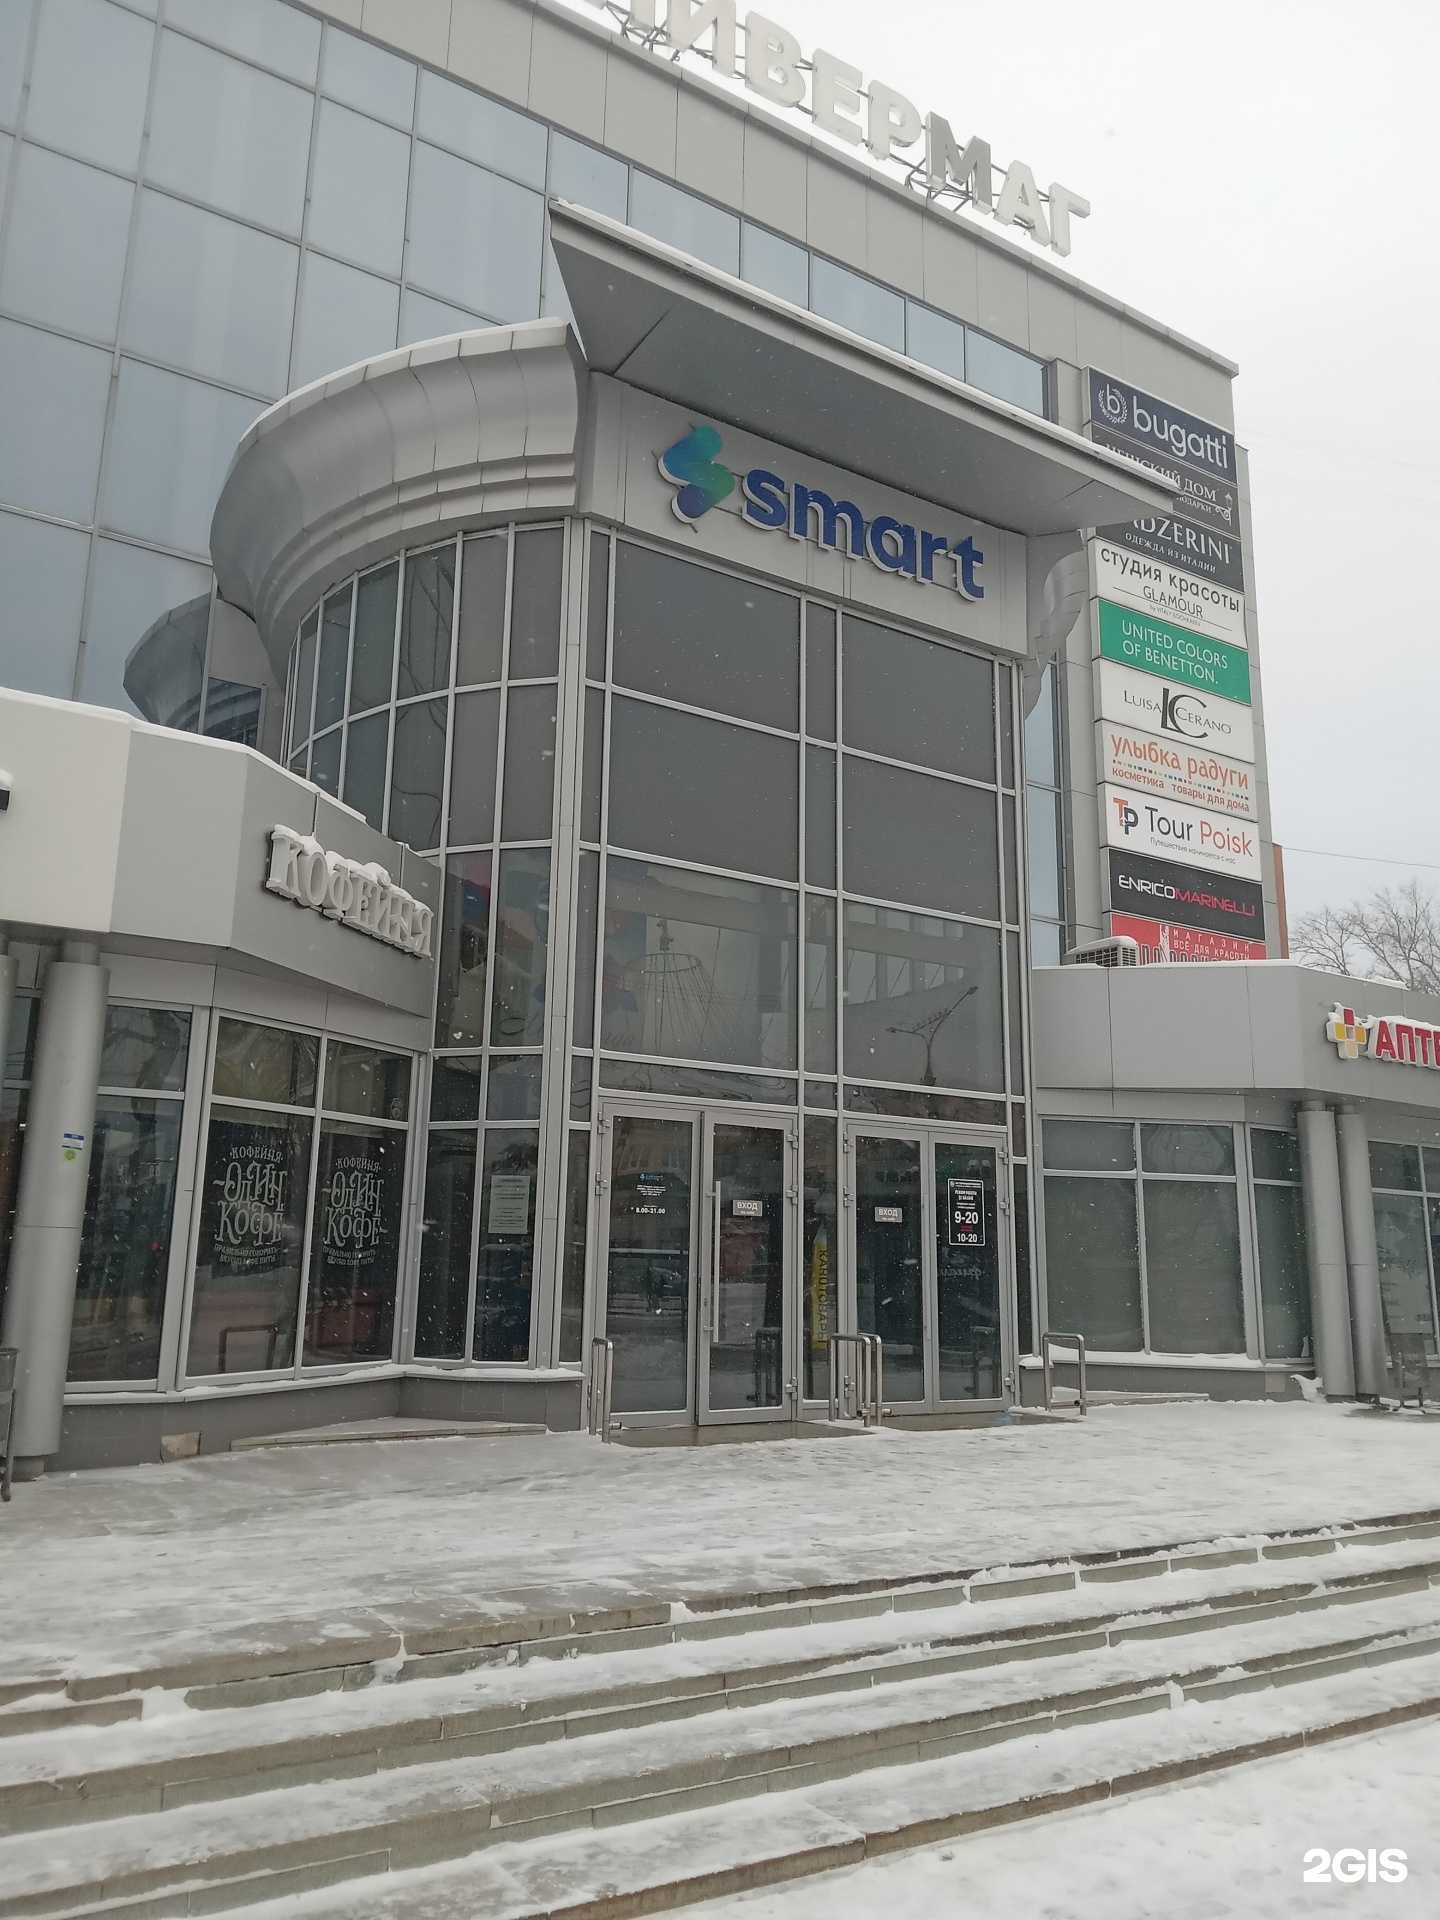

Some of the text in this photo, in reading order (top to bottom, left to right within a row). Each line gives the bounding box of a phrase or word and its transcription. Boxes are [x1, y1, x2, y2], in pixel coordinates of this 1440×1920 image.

[588, 0, 1092, 257] ИВЕРМАГ
[1132, 395, 1229, 469] bugatti
[1183, 478, 1217, 502] ДОМ
[741, 468, 985, 602] smart
[1125, 532, 1216, 574] ОДЕЖДА ИЗ ИТАЛИИ
[1131, 517, 1230, 565] DZERINI
[1143, 585, 1204, 618] GLAMOUR
[1168, 573, 1240, 613] красоты
[1122, 619, 1173, 648] UNITED
[1176, 639, 1228, 669] COLORS
[1122, 640, 1218, 684] OF BENETTON.
[1124, 690, 1232, 734] LUISA CERANO
[1111, 734, 1249, 790] улыбка радуги
[1112, 767, 1249, 812] косметика товары для дома
[1145, 805, 1253, 857] Tour Poisk
[1173, 929, 1250, 952] МАГАЗИН
[1194, 943, 1210, 955] ДЛЯ
[232, 1145, 282, 1164] КОФЕЙНЯ
[337, 1157, 379, 1172] КОФЕЙНЯ
[736, 1201, 758, 1211] ВХОД
[878, 1208, 898, 1217] ВХОД
[954, 1211, 979, 1225] 9-20
[957, 1233, 978, 1243] 10-20
